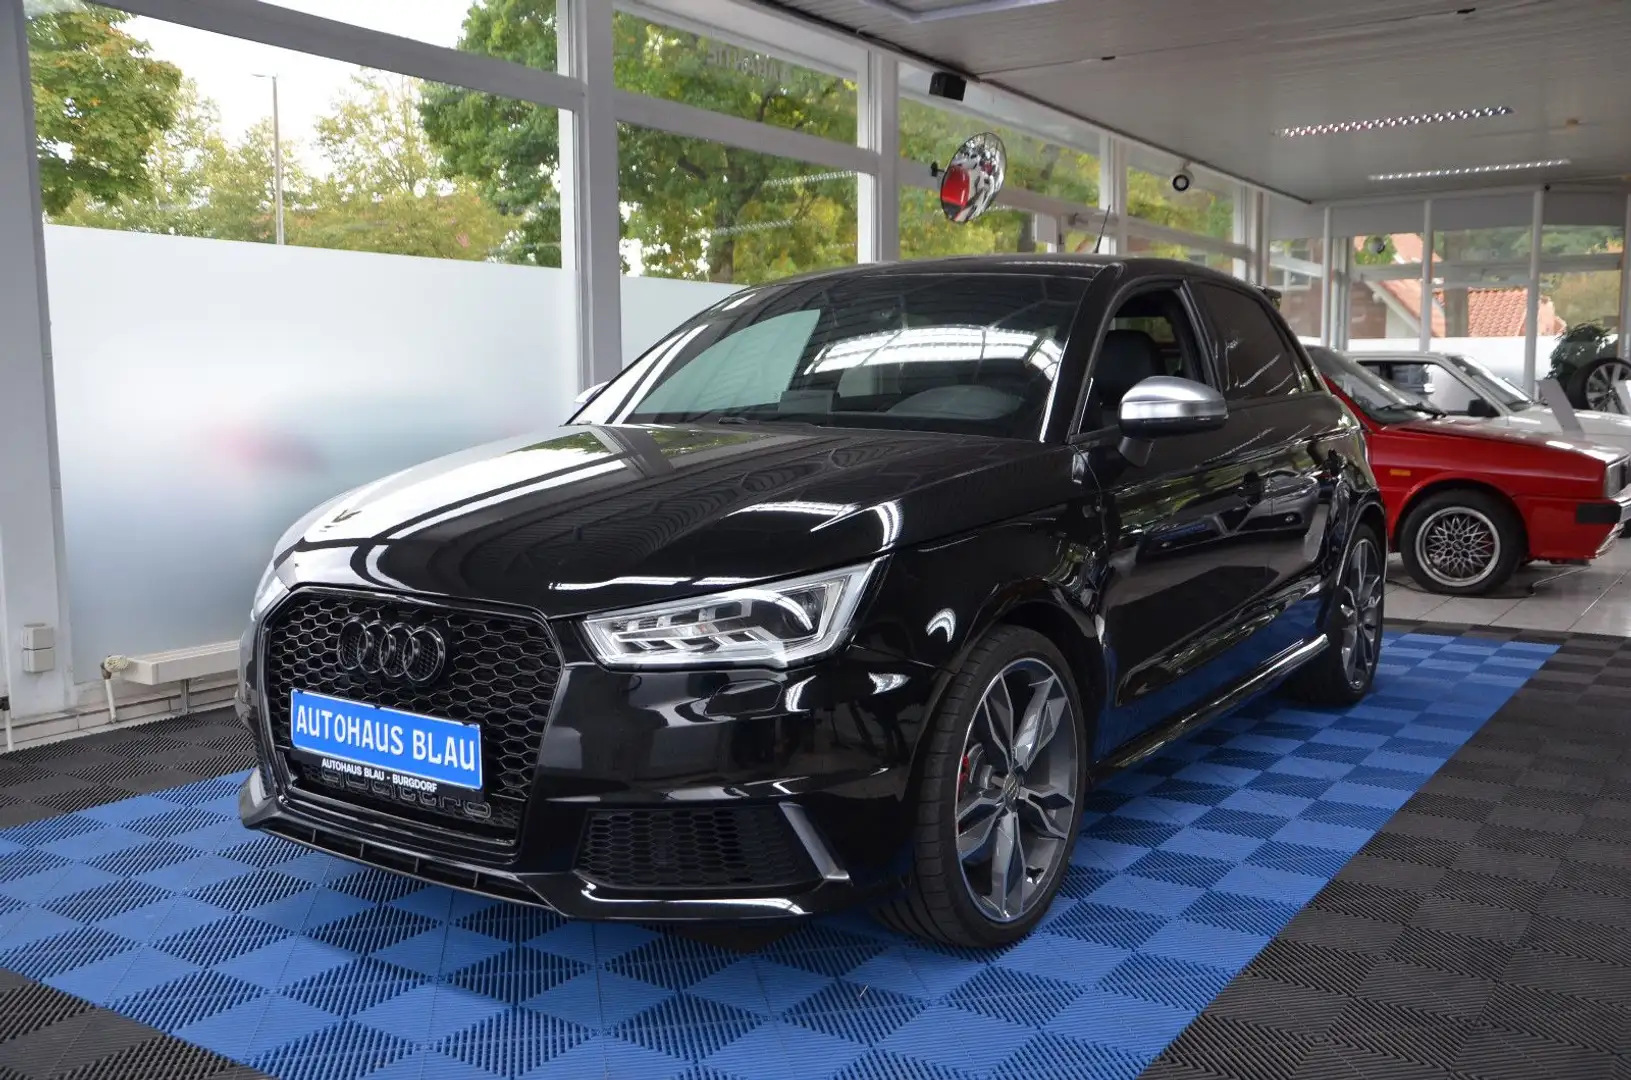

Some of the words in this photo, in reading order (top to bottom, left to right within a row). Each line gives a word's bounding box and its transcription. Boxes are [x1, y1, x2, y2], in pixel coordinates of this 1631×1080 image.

[296, 704, 404, 756] AUTOHAUS
[412, 729, 475, 771] BLAU
[321, 757, 362, 776] AUTOHAUS
[363, 768, 385, 781] BLAU
[392, 774, 438, 793] BURGDORF
